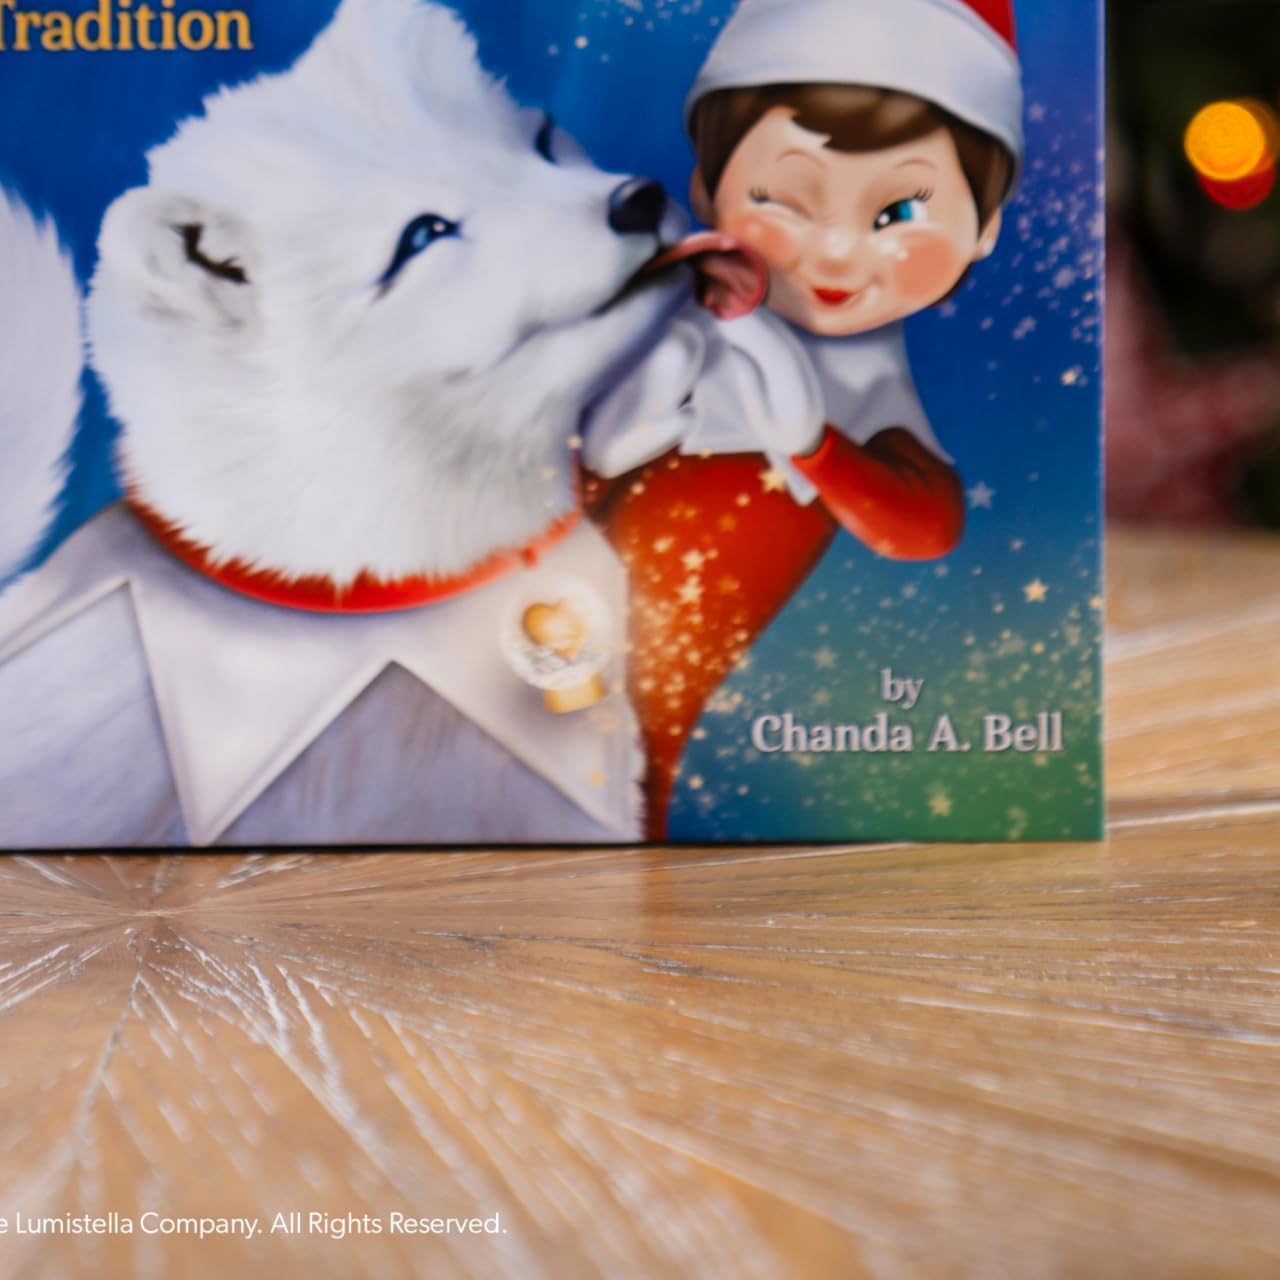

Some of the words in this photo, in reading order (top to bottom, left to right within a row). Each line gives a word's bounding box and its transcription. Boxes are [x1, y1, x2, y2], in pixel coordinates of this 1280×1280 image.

[880, 668, 924, 709] by
[751, 712, 913, 752] Chanda
[927, 714, 971, 752] A.
[983, 712, 1064, 752] Bell
